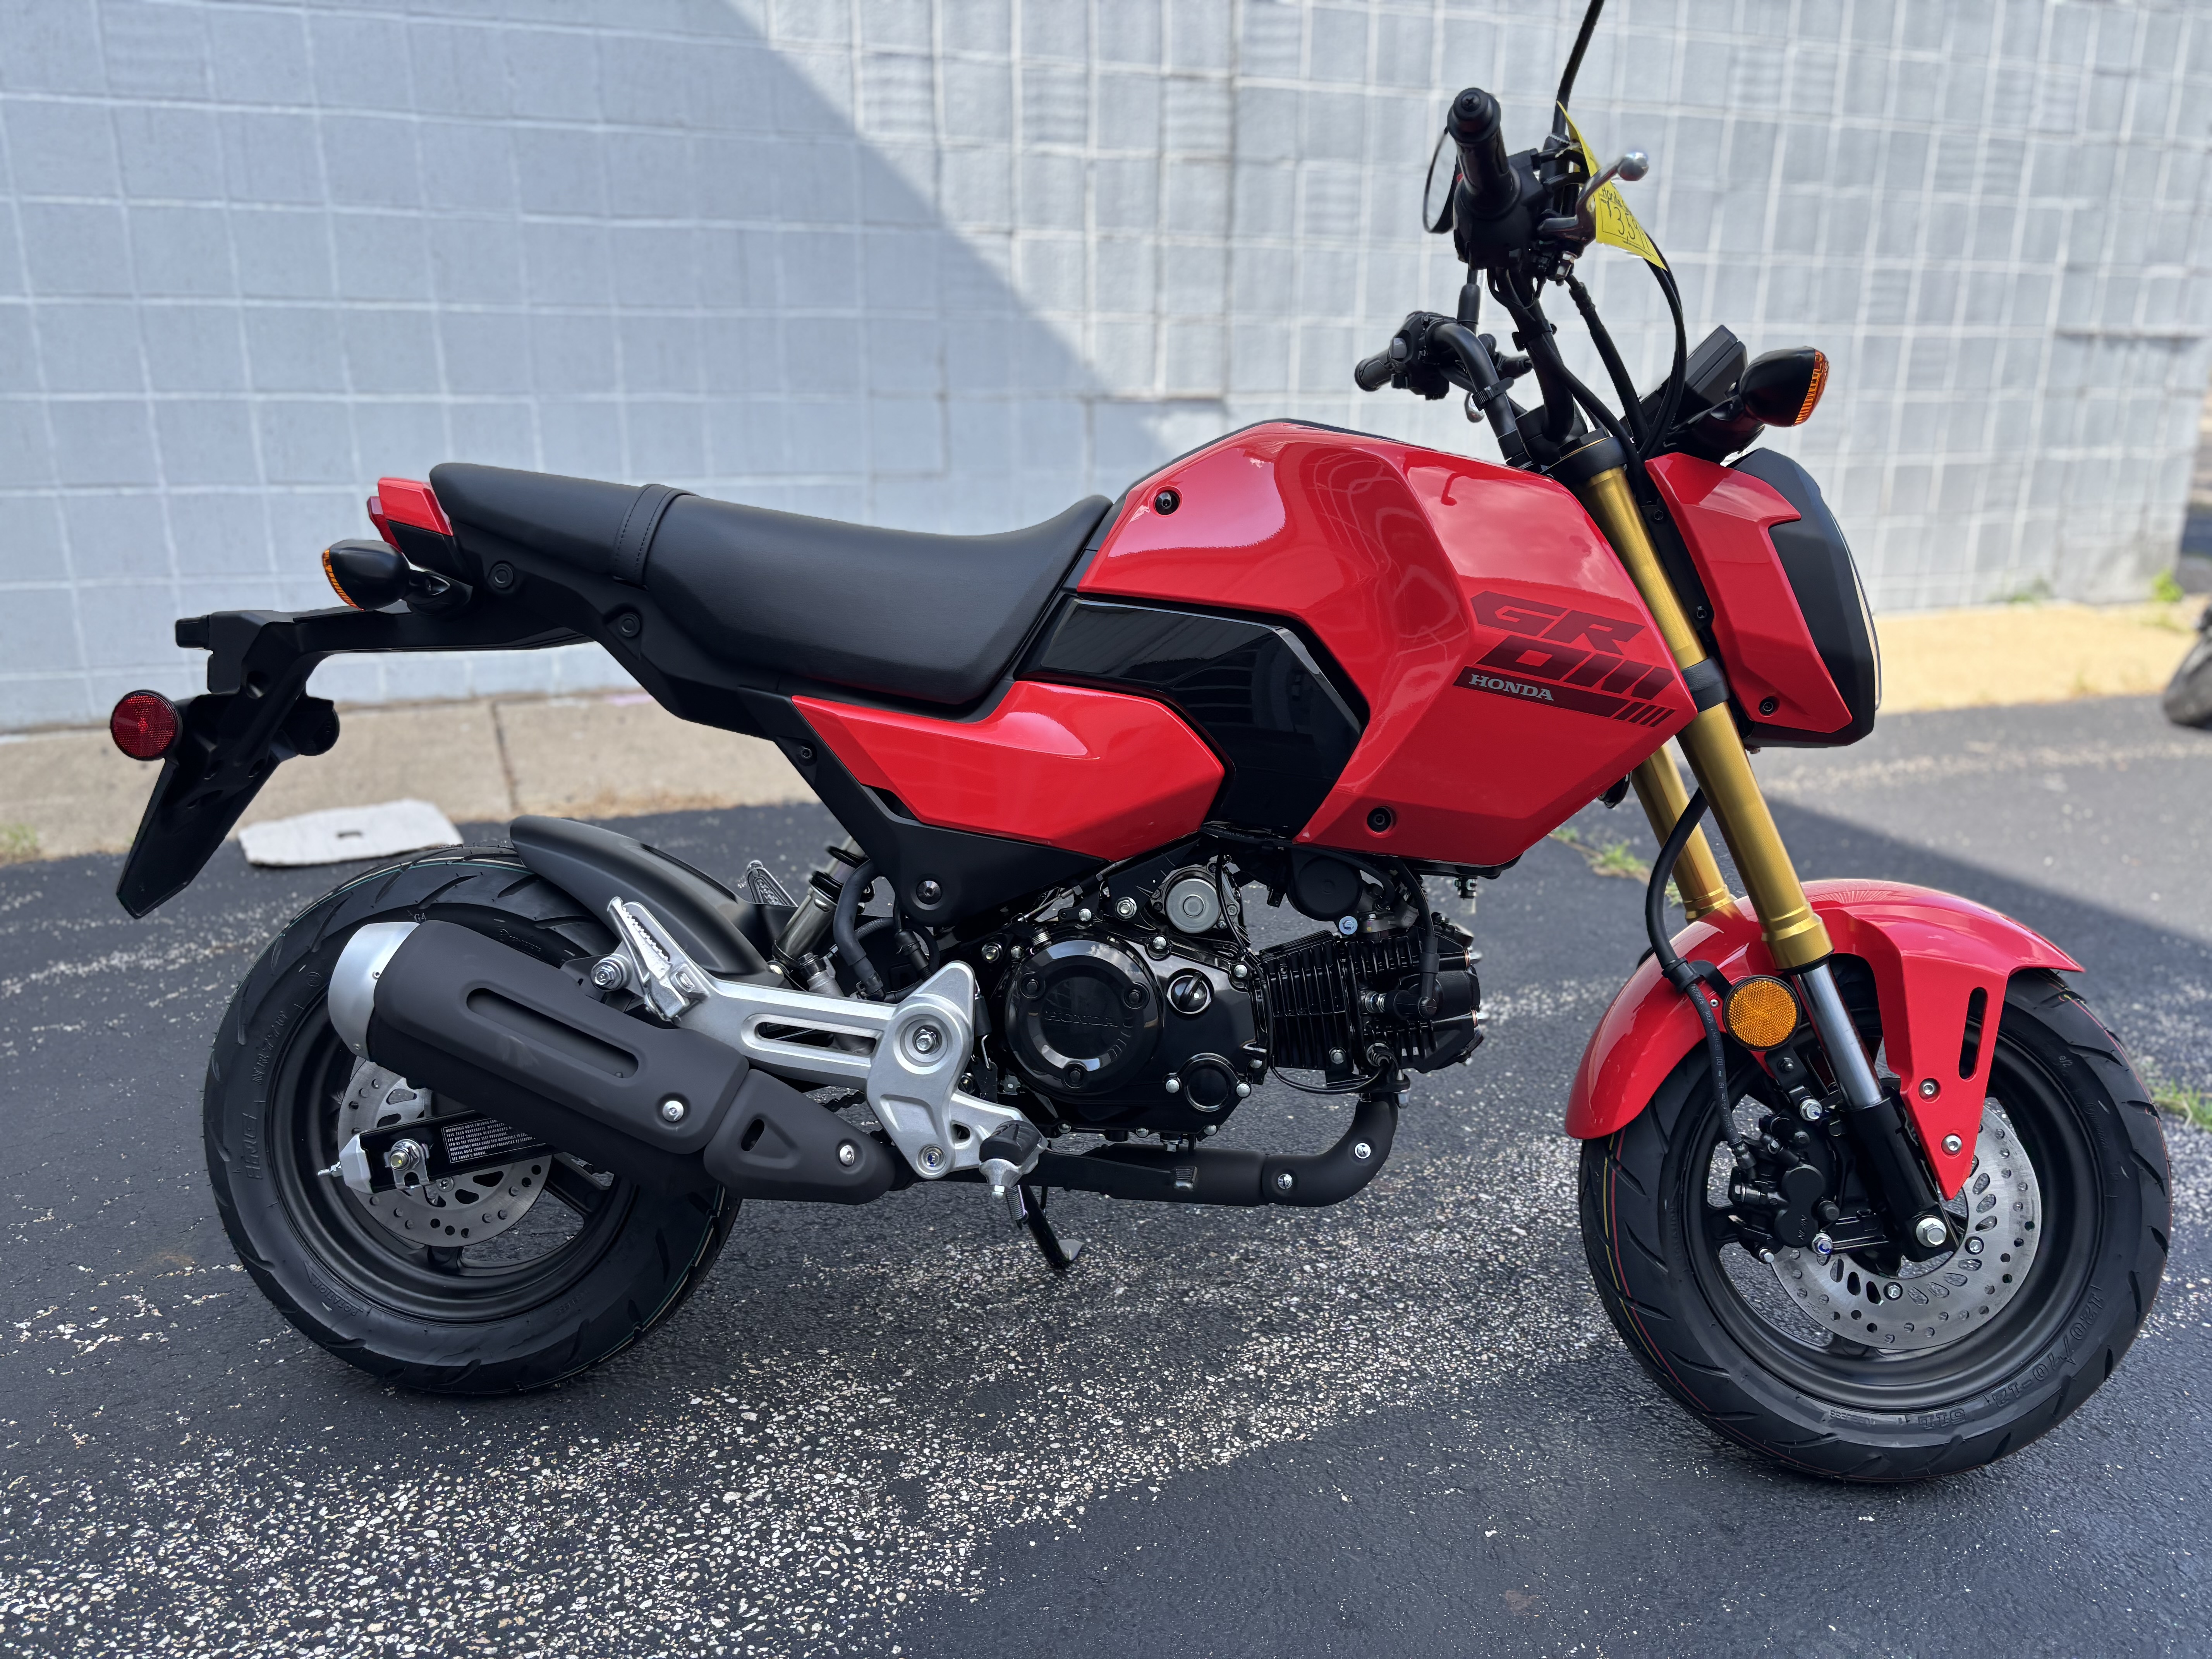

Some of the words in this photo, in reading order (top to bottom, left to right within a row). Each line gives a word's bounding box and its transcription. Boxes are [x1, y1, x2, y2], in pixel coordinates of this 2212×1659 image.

[1470, 591, 1645, 655] GR
[1469, 674, 1554, 701] HONDA
[1044, 1011, 1118, 1027] HONDA
[313, 1279, 358, 1317] ROTATION
